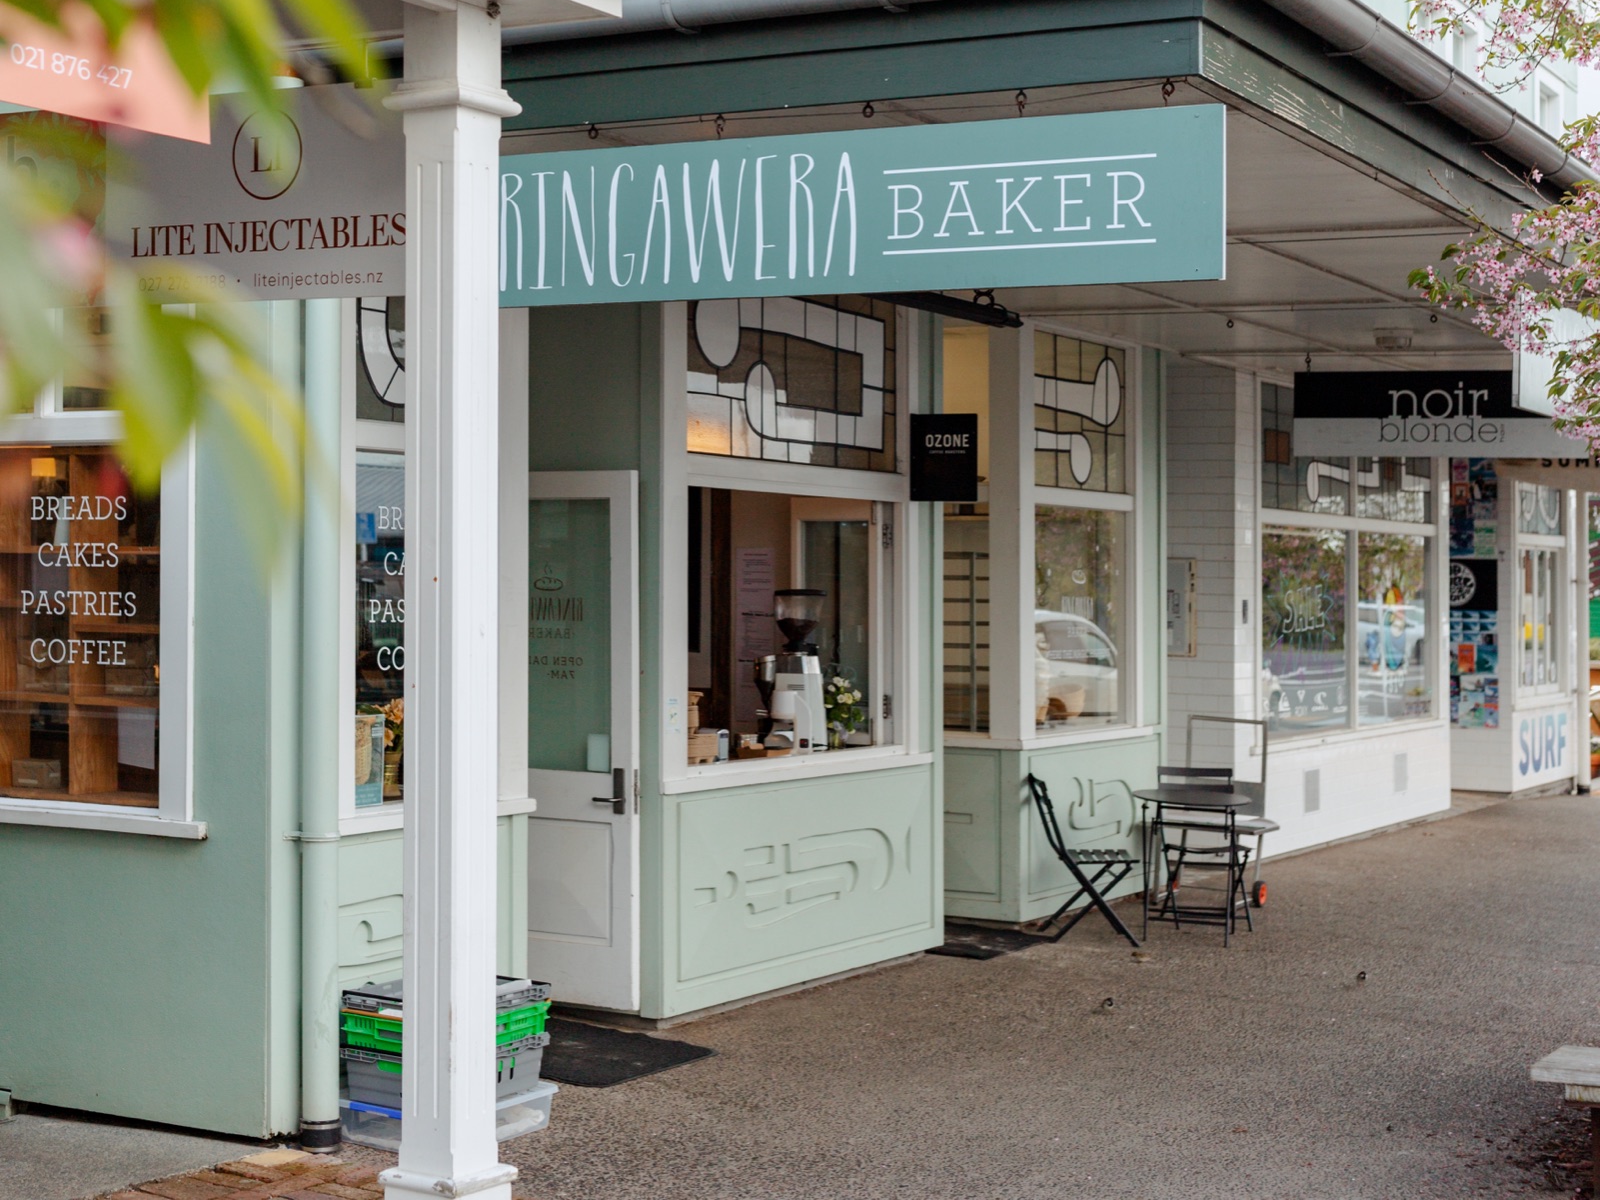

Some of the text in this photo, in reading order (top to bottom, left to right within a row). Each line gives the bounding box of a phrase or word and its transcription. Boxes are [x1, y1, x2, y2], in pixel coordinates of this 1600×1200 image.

[10, 43, 133, 89] 021 876 427
[131, 212, 406, 258] LITE INJECTABLES
[499, 151, 1152, 292] RINGAWERA BAKER
[253, 270, 383, 290] liteinjectables.nz
[1388, 381, 1488, 419] noir
[925, 434, 970, 448] OZONE
[1378, 418, 1498, 443] blonde
[31, 495, 127, 521] BREADS
[38, 542, 119, 568] CAKES
[21, 590, 137, 617] PASTRIES
[1283, 584, 1325, 633] SALE
[30, 638, 126, 666] COFFEE
[1519, 712, 1567, 776] SURF
